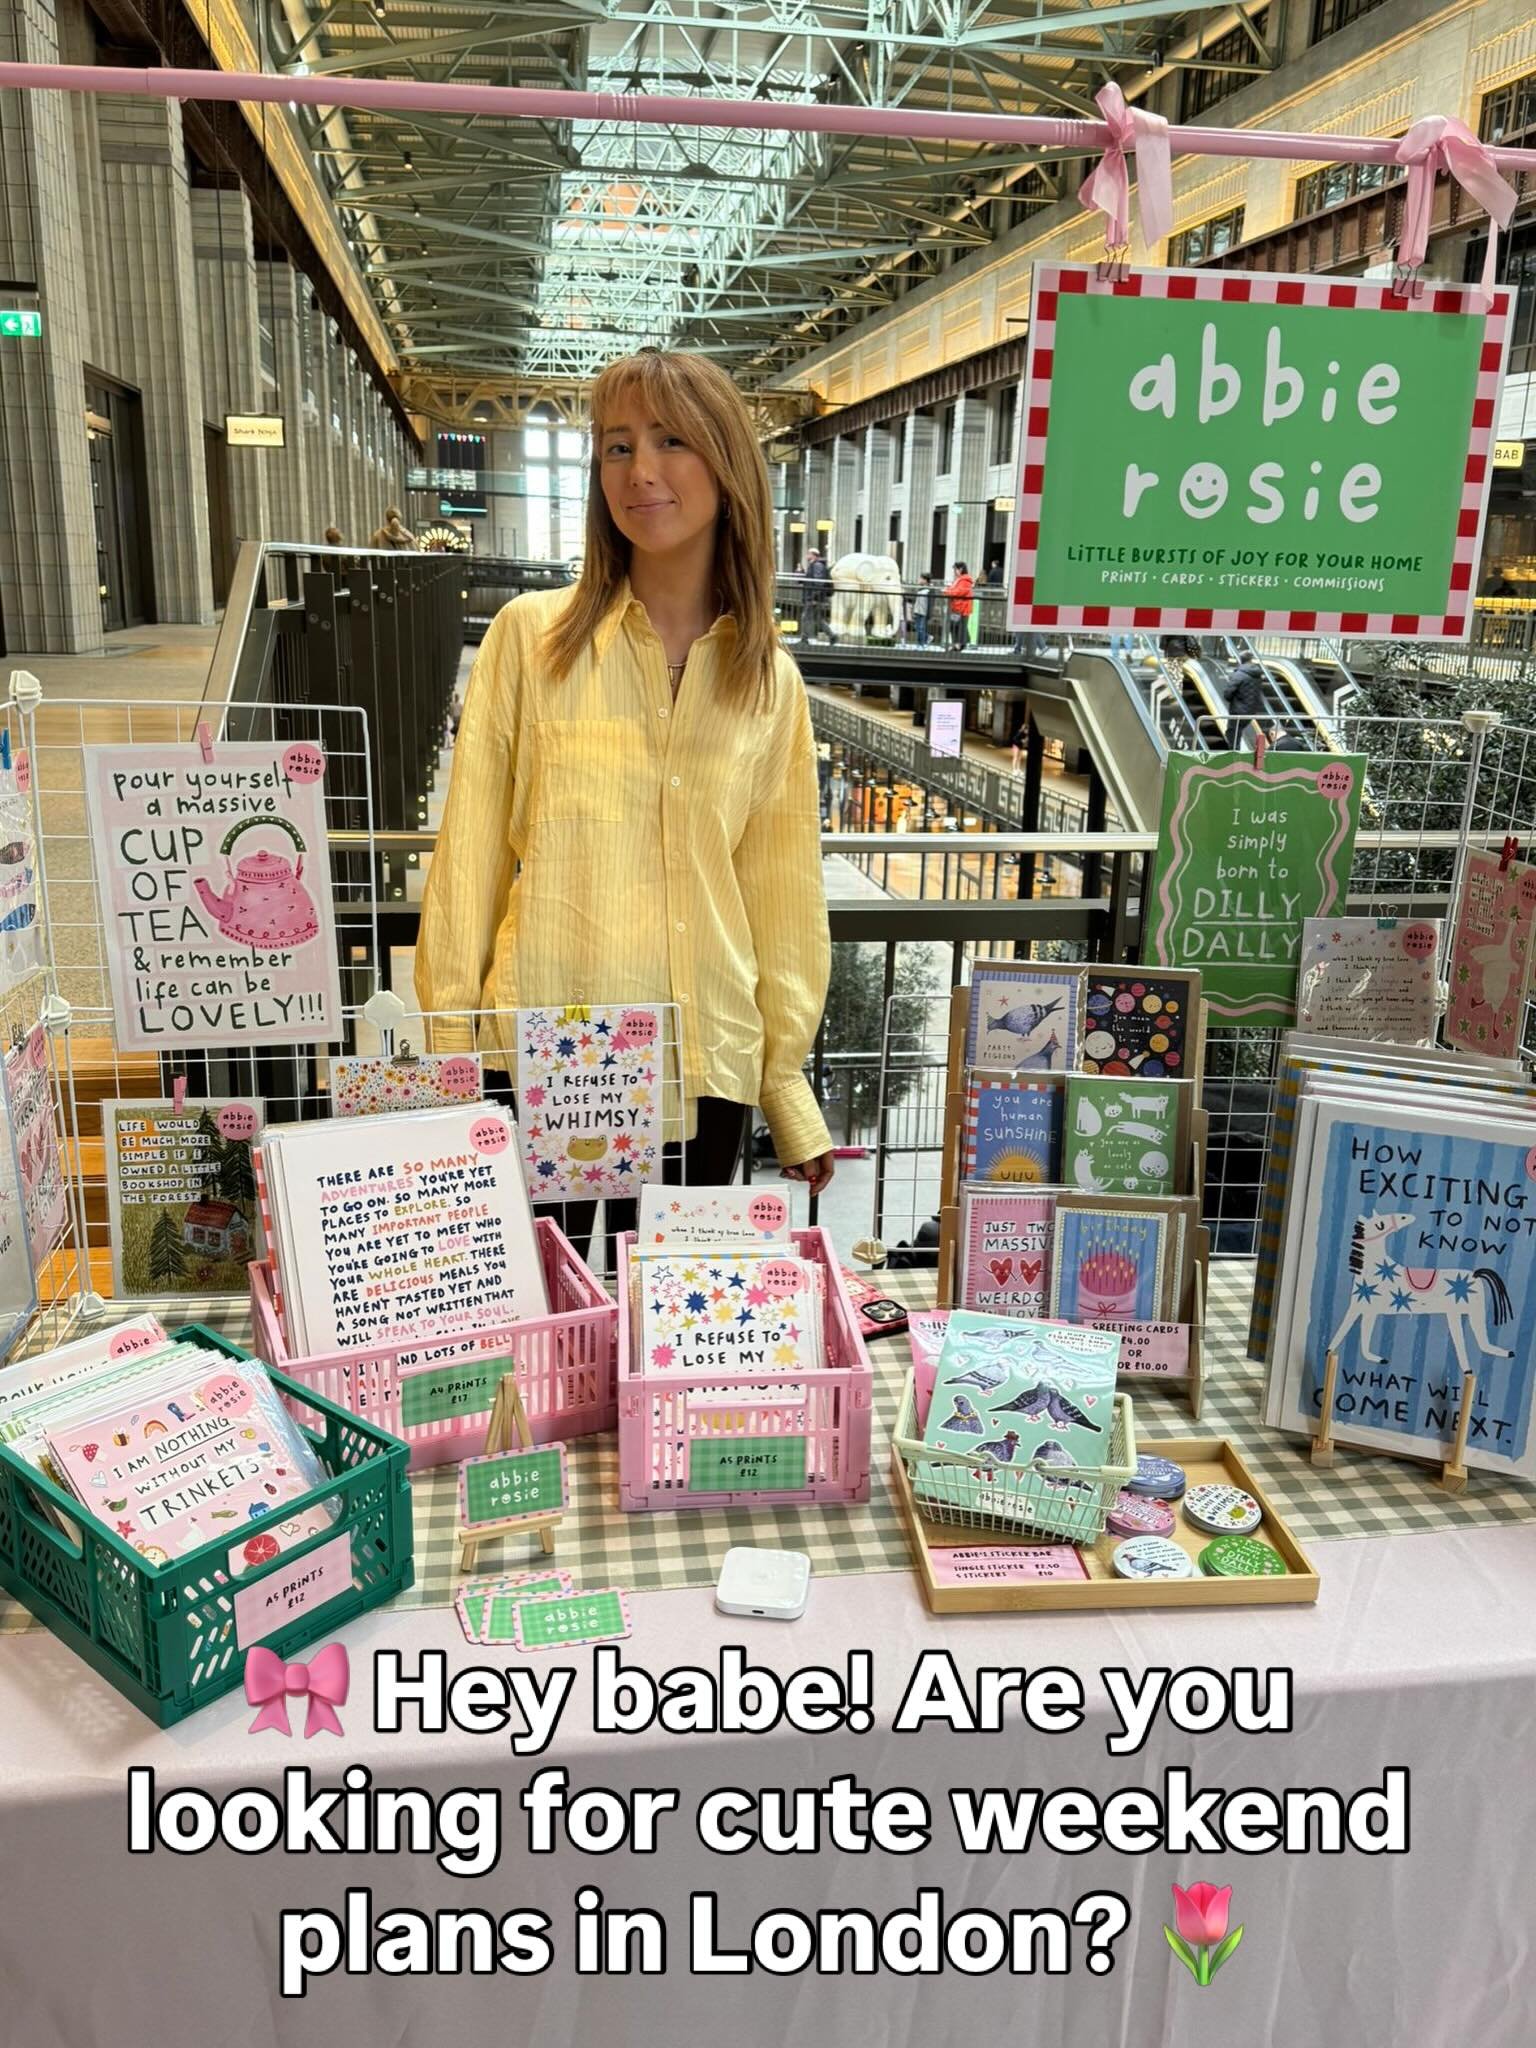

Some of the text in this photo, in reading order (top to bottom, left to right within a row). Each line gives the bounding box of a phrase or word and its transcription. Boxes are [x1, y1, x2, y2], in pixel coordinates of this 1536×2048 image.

[1129, 322, 1401, 427] abbie
[1123, 461, 1383, 524] rosie
[1131, 546, 1197, 565] BURSTS
[1202, 549, 1226, 566] OF
[1231, 550, 1268, 567] JOY
[1275, 552, 1309, 569] FOR
[1316, 553, 1365, 570] YOUR
[1371, 555, 1423, 572] HOME
[1161, 572, 1204, 585] CARDS
[289, 753, 322, 766] abbie
[288, 764, 321, 776] rosie
[1322, 771, 1350, 782] abbie
[113, 760, 293, 801] pour yourself
[1321, 781, 1348, 792] rosie
[146, 794, 277, 817] a massive
[1231, 808, 1289, 826] I was
[120, 826, 204, 865] CUP
[1227, 831, 1289, 858] simply
[1216, 857, 1289, 880] born to
[131, 870, 188, 901] OF
[1194, 888, 1301, 921] DILLY
[118, 906, 208, 943] TEA
[1182, 929, 1300, 959] DALLY
[133, 946, 293, 972] & remember
[137, 971, 271, 1009] life can be
[139, 993, 325, 1034] LOVELY!!!
[625, 1018, 655, 1029] abbie
[625, 1028, 654, 1038] rosie
[546, 1074, 639, 1089] I REFUSE TO
[552, 1092, 623, 1107] LOSE MY
[992, 1095, 1054, 1110] you are
[545, 1108, 640, 1131] WHIMSY
[1000, 1107, 1045, 1122] human
[119, 1119, 200, 1132] LIFE WOULD
[476, 1126, 505, 1139] abbie
[121, 1135, 210, 1147] BE MUCH MORE
[478, 1134, 507, 1147] rosie
[122, 1149, 200, 1161] SIMPLE IF I
[1352, 1137, 1423, 1166] HOW
[121, 1163, 221, 1176] OWNED A LITTLE
[317, 1153, 480, 1188] THERE ARE SO MANY
[121, 1179, 201, 1191] BOOKSHOP IN
[321, 1177, 415, 1203] ADVENTURES
[469, 1165, 493, 1179] YET
[1359, 1170, 1529, 1209] EXCITING
[123, 1192, 201, 1202] THE FOREST.
[320, 1177, 497, 1217] TO GO ON. SO MANY MORE
[754, 1201, 783, 1212] abbie
[321, 1196, 471, 1232] PLACES TO EXPLORE. SO
[753, 1213, 782, 1222] rosie
[1430, 1209, 1536, 1236] TO NOT
[984, 1221, 1017, 1233] JUST
[1079, 1217, 1149, 1241] birthday
[1418, 1231, 1508, 1255] KNOW
[766, 1277, 798, 1288] rosie
[767, 1267, 798, 1279] abbie
[676, 1330, 781, 1347] I REFUSE TO
[1146, 1325, 1179, 1335] CARDS
[1120, 1336, 1150, 1346] £4.00
[683, 1350, 766, 1368] LOSE MY
[1128, 1349, 1142, 1359] OR
[1135, 1362, 1169, 1372] £10.00
[429, 1385, 445, 1397] A4
[1342, 1369, 1418, 1393] WHAT
[209, 1380, 240, 1405] abbie
[218, 1389, 247, 1413] rosie
[1313, 1388, 1410, 1423] COME
[112, 1416, 232, 1480] I AM NOTHING
[134, 1438, 237, 1496] WITHOUT MY
[489, 1468, 541, 1489] abbie
[139, 1459, 261, 1526] TRINKETS
[490, 1486, 541, 1507] rosie
[544, 1605, 599, 1624] abbie
[545, 1618, 599, 1635] rosie
